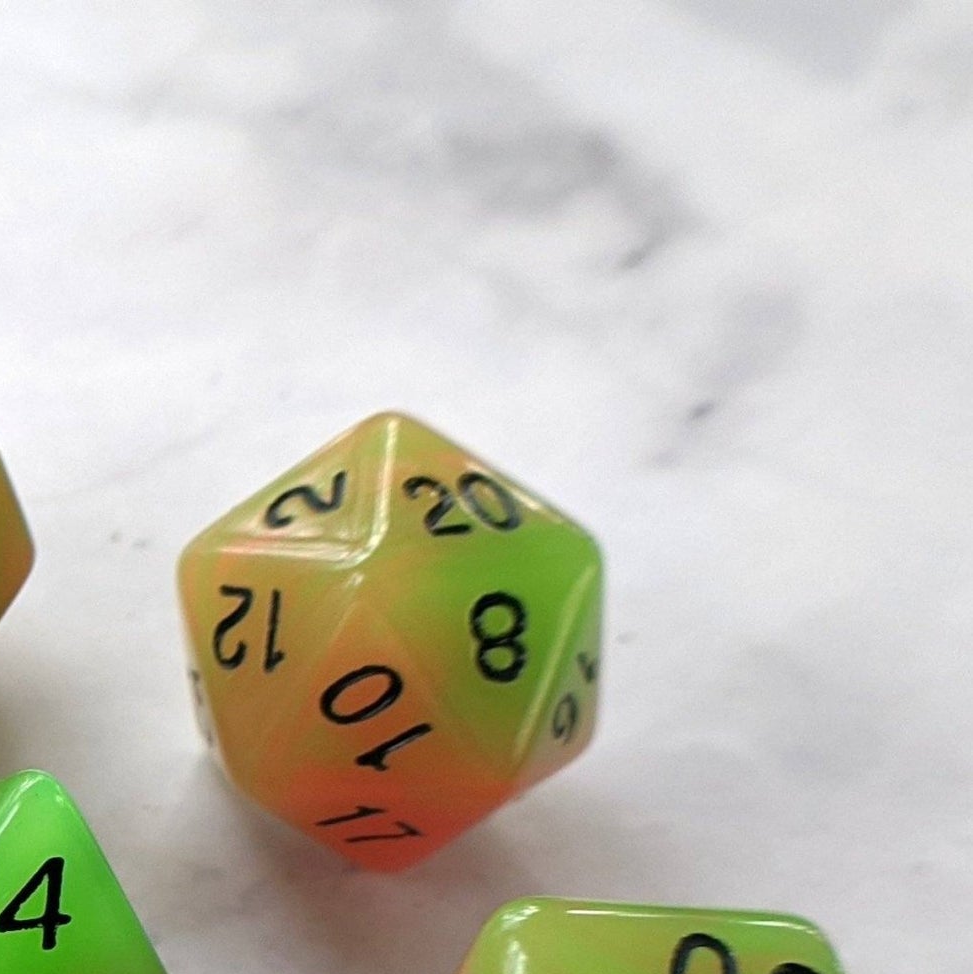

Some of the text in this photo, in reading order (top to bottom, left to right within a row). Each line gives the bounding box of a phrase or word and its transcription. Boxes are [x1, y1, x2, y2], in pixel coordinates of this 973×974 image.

[266, 472, 345, 528] 2
[404, 473, 521, 536] 20
[214, 586, 284, 672] 12
[471, 592, 525, 682] 8
[321, 666, 432, 771] 10
